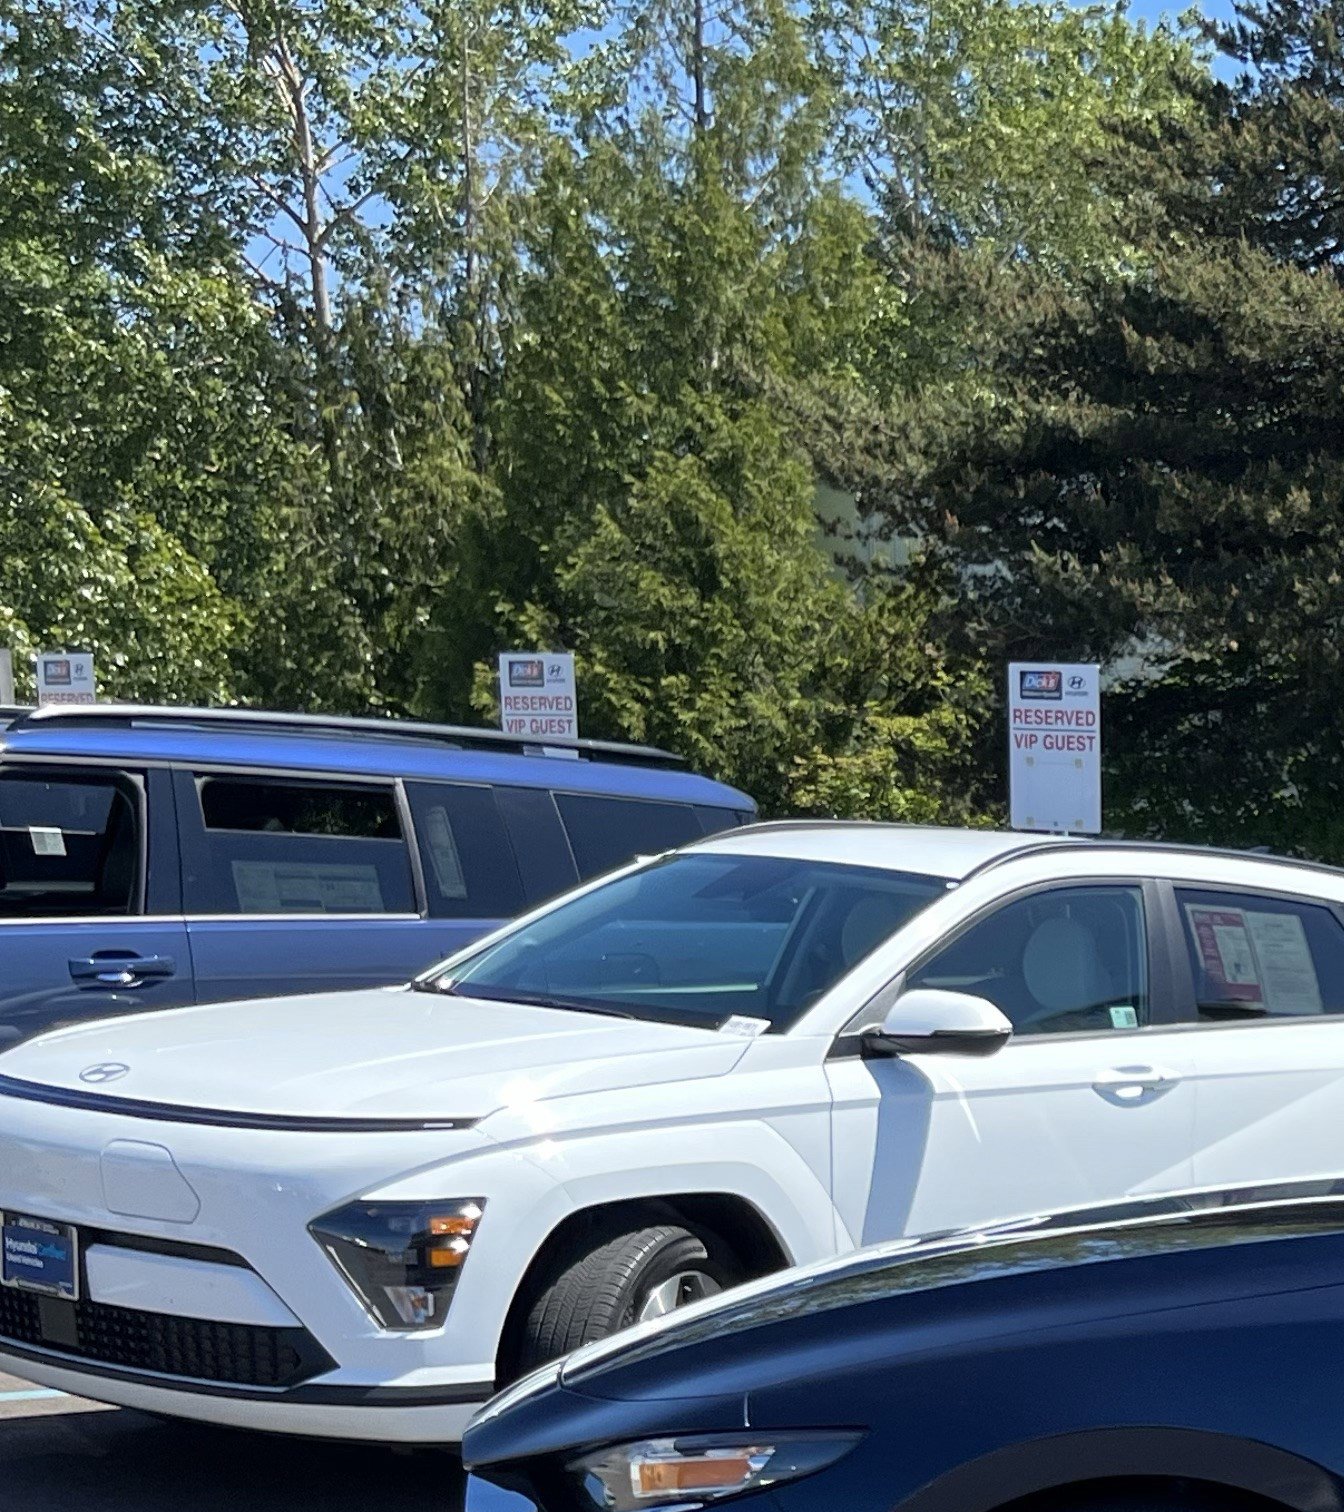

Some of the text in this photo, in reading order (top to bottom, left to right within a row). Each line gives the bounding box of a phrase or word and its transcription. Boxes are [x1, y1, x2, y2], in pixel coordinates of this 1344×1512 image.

[504, 695, 573, 711] RESERVED
[506, 718, 573, 735] VIP GUEST
[1013, 708, 1096, 727] RESERVED
[1014, 733, 1096, 753] VIP GUEST
